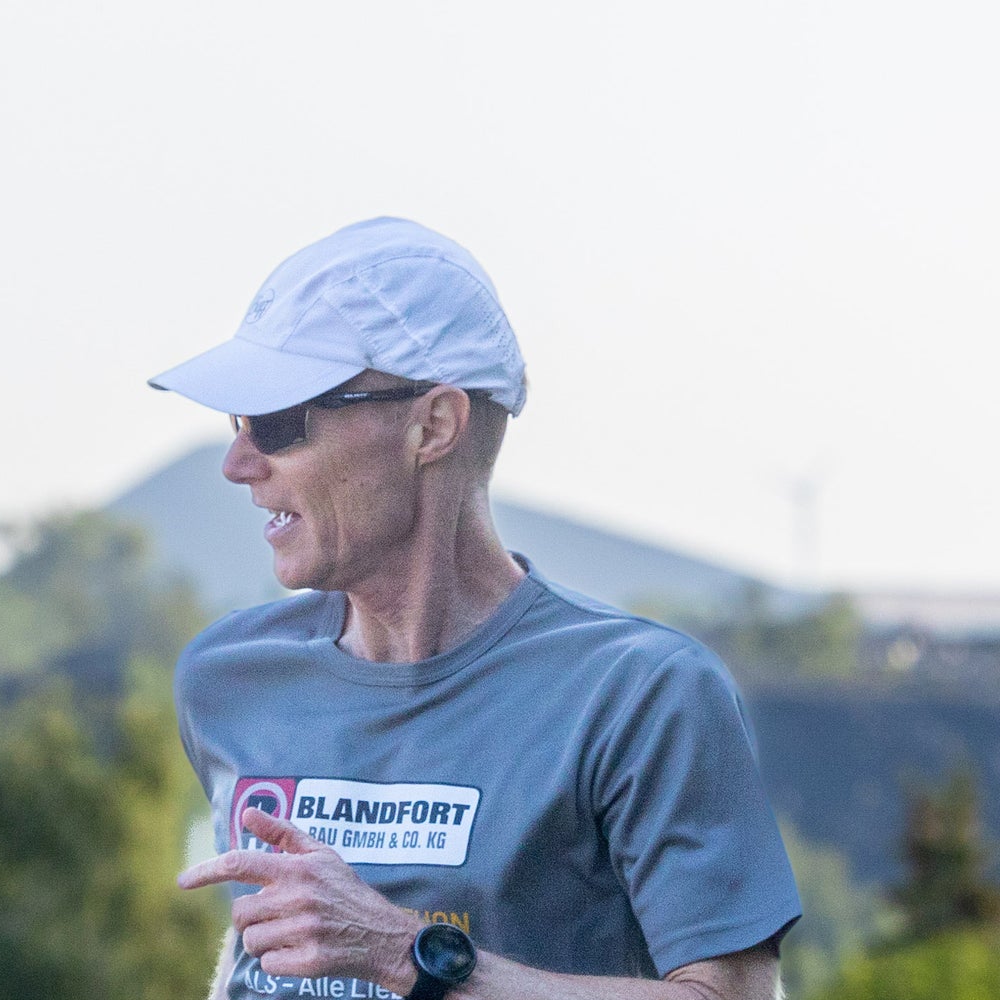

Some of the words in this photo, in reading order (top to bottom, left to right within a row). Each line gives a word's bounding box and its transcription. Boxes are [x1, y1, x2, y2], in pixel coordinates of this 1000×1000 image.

[296, 796, 471, 826] BLANDFORT
[342, 829, 386, 850] GMBH
[388, 832, 398, 848] &
[402, 830, 421, 849] CO.
[426, 831, 447, 850] KG
[351, 977, 405, 1000] Lie
